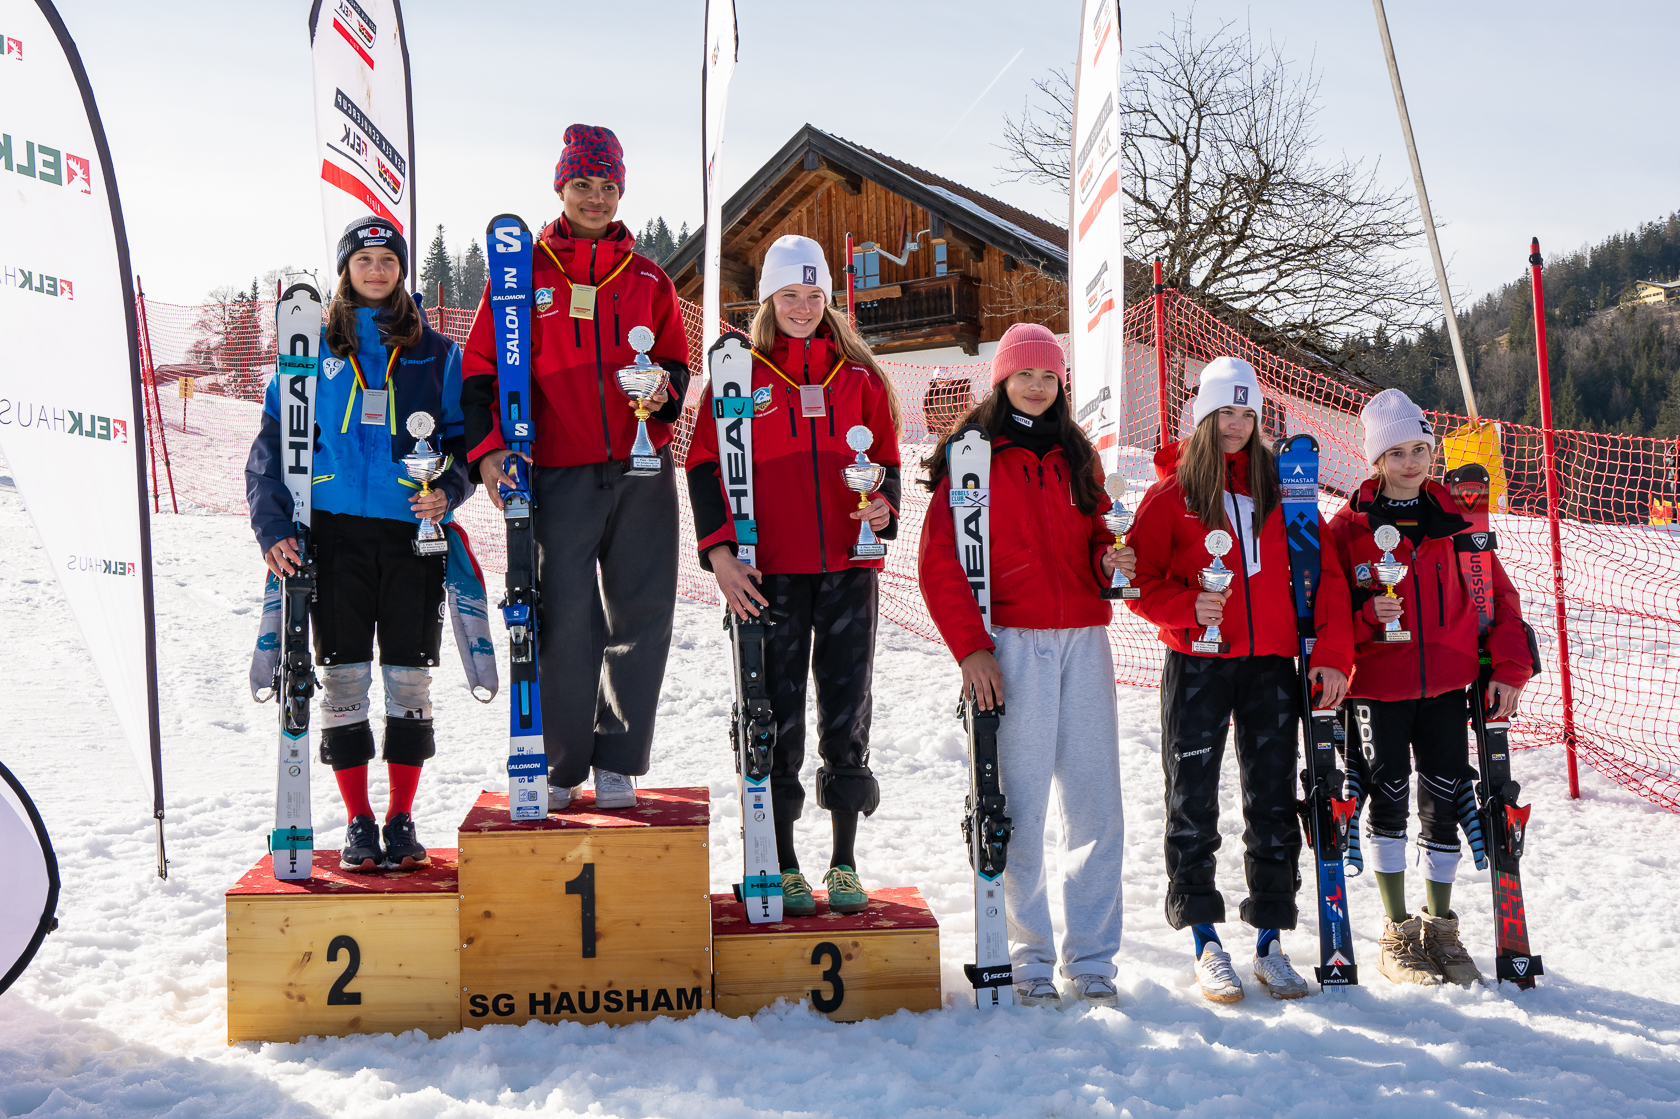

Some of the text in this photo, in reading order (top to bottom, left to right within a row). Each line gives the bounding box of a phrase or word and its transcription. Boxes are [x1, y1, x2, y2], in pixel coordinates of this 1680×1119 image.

[279, 361, 315, 369] HEAD
[1470, 550, 1486, 614] ROSSIGN
[1357, 705, 1375, 760] POC
[566, 863, 595, 959] 1
[327, 935, 362, 1006] 2
[811, 941, 844, 1014] 3
[990, 972, 1012, 980] SCO
[469, 985, 704, 1018] SG HAUSHAM
